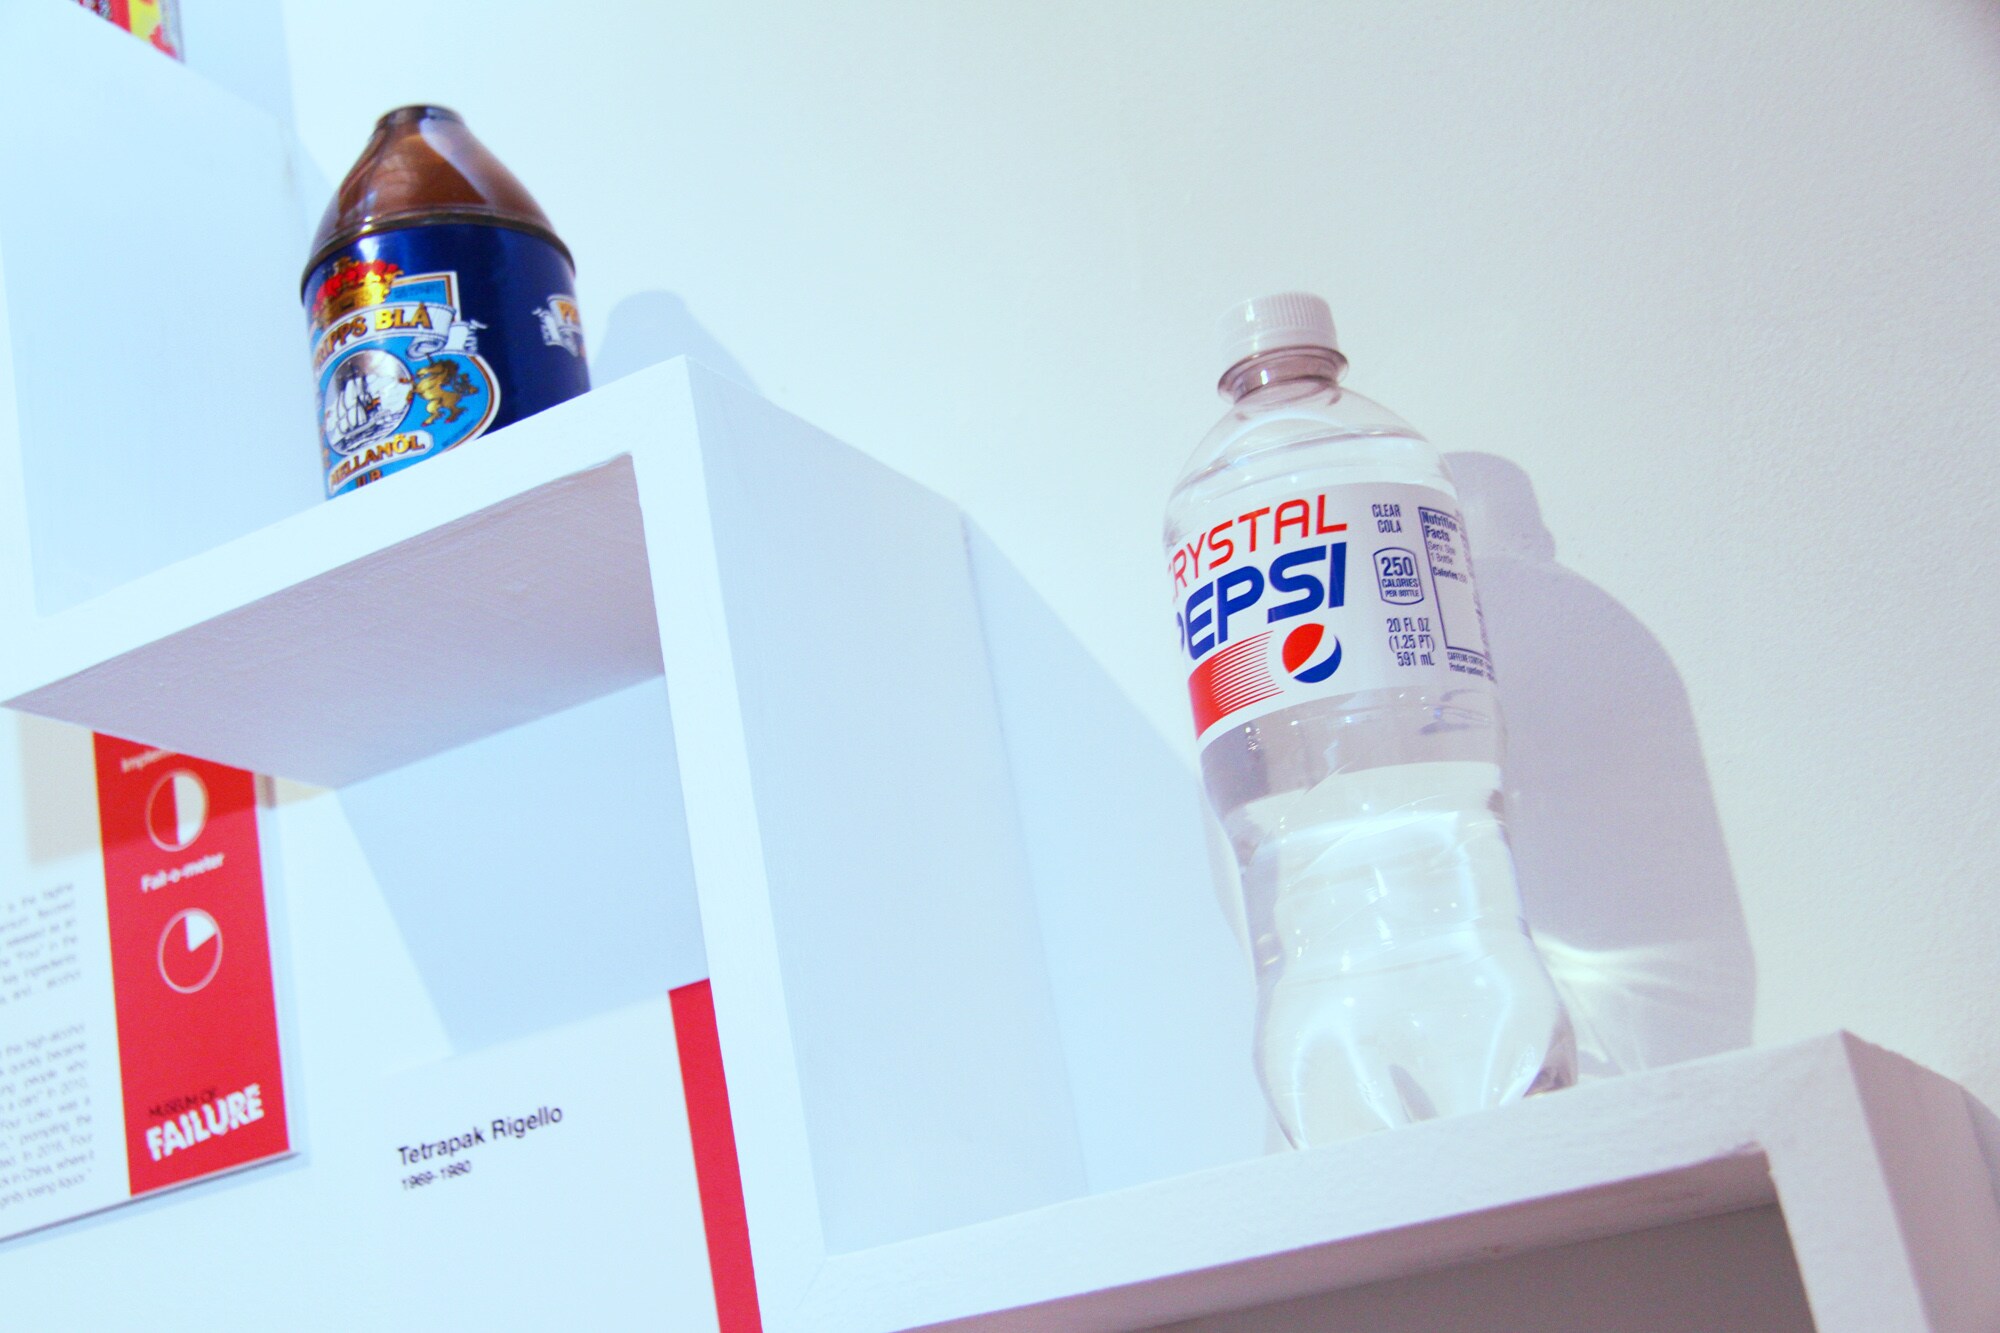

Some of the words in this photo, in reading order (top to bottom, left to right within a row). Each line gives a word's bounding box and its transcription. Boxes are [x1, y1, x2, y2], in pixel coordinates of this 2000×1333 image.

[375, 303, 433, 331] BLÅ
[1371, 503, 1401, 518] CLEAR
[1377, 519, 1402, 533] COLA
[1421, 511, 1458, 532] Nutrition
[1424, 525, 1451, 542] Facts
[1167, 494, 1347, 604] RYSTAL
[1380, 556, 1414, 577] 250
[1381, 578, 1419, 588] CALORIES
[1176, 541, 1347, 661] EPSI
[1399, 589, 1420, 598] BOTTLE
[1386, 617, 1401, 633] 20
[1403, 617, 1416, 632] FL
[1417, 617, 1431, 632] OZ
[1389, 634, 1416, 653] (1.25
[1418, 634, 1435, 652] PT)
[1397, 651, 1417, 667] 591
[1420, 652, 1435, 666] mL
[145, 1083, 265, 1162] FAILURE
[398, 1127, 486, 1166] Tetrapak
[491, 1106, 563, 1139] Rigello
